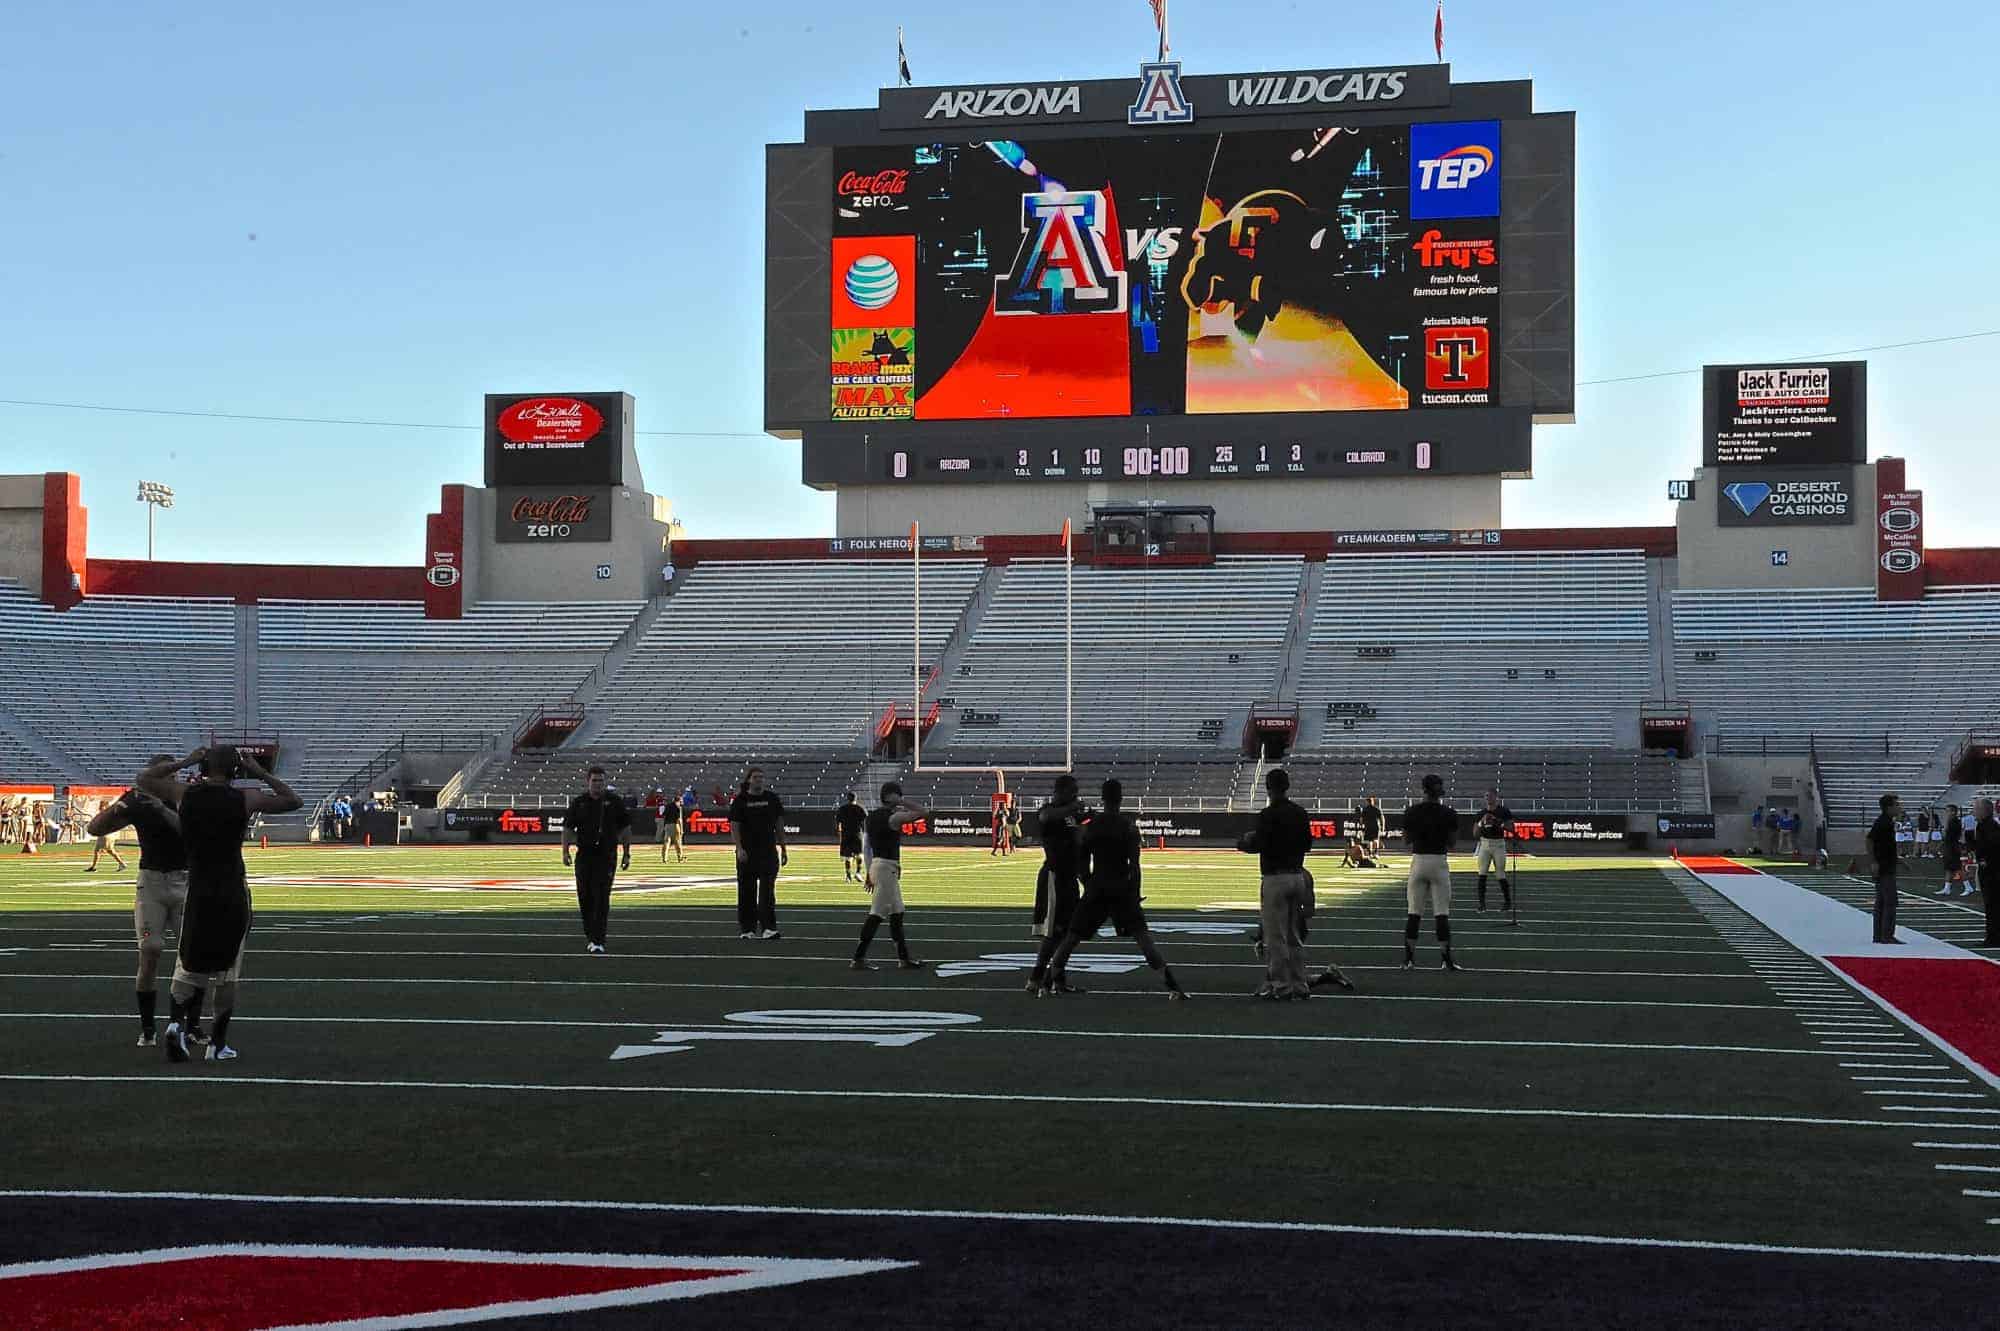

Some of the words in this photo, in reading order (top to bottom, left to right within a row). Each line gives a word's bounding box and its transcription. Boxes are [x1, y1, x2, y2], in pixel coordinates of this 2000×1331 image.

[1228, 71, 1407, 106] WILDCATS
[924, 87, 1080, 119] ARIZONA
[1418, 157, 1484, 190] TEP
[1412, 229, 1496, 268] fry's
[1430, 275, 1454, 284] fresh
[1413, 287, 1448, 296] famous
[1450, 286, 1467, 295] low
[1468, 285, 1498, 296] prices
[1422, 317, 1450, 326] Arizona
[1451, 316, 1470, 326] Daily
[1471, 315, 1488, 325] Star
[1740, 372, 1774, 389] Jack
[1779, 370, 1827, 388] Furrier
[835, 387, 911, 406] MAX
[1422, 393, 1488, 404] tucson.com
[833, 408, 868, 417] AUTO
[869, 407, 911, 416] GLASS
[1742, 406, 1827, 416] JackFurriers.com
[1733, 417, 1762, 425] Thanks
[1018, 450, 1027, 465] 3
[1051, 450, 1058, 464] 1
[1084, 449, 1100, 464] 10
[1216, 446, 1233, 462] 25
[1259, 446, 1266, 461] 1
[1291, 445, 1300, 461] 3
[1346, 452, 1385, 463] COLORADO
[1416, 443, 1430, 469] 0
[940, 459, 970, 470] ARIZONA
[1124, 447, 1189, 475] 90:00
[1210, 465, 1227, 473] BALL
[1669, 481, 1688, 499] 40
[1777, 482, 1840, 492] DESERT
[1769, 493, 1848, 504] DIAMOND
[1771, 505, 1846, 516] CASINOS
[527, 524, 570, 537] zero
[1337, 533, 1416, 544] #TEAMKADEEM
[1486, 532, 1499, 543] 13
[850, 540, 877, 550] FOLK
[1146, 544, 1159, 555] 12
[1772, 553, 1787, 564] 14
[597, 566, 610, 578] 10
[498, 810, 543, 833] fry's
[687, 811, 732, 833] fry's
[1553, 822, 1572, 830] fresh
[1598, 831, 1624, 840] prices
